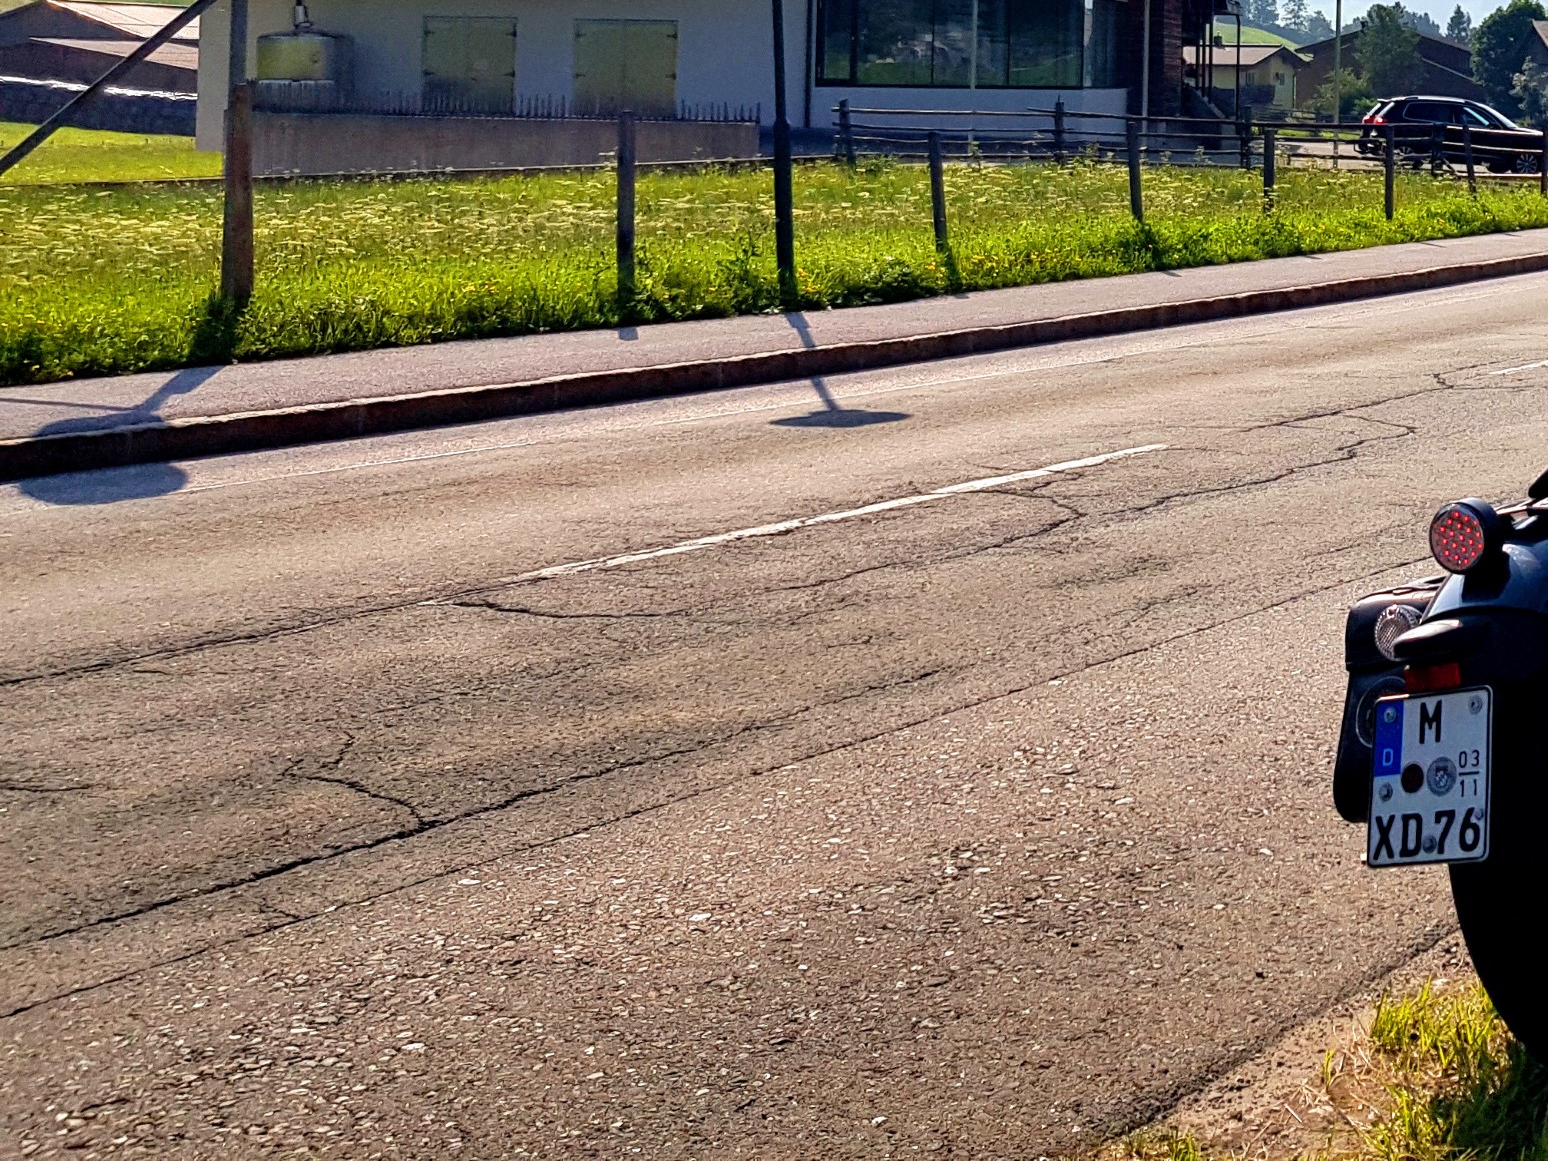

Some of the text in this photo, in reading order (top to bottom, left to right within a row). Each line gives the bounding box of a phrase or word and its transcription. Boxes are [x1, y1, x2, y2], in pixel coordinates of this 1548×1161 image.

[1418, 699, 1443, 745] M
[1381, 747, 1394, 767] D
[1458, 749, 1480, 769] 03
[1459, 779, 1478, 798] 11
[1373, 806, 1481, 861] XD 76
